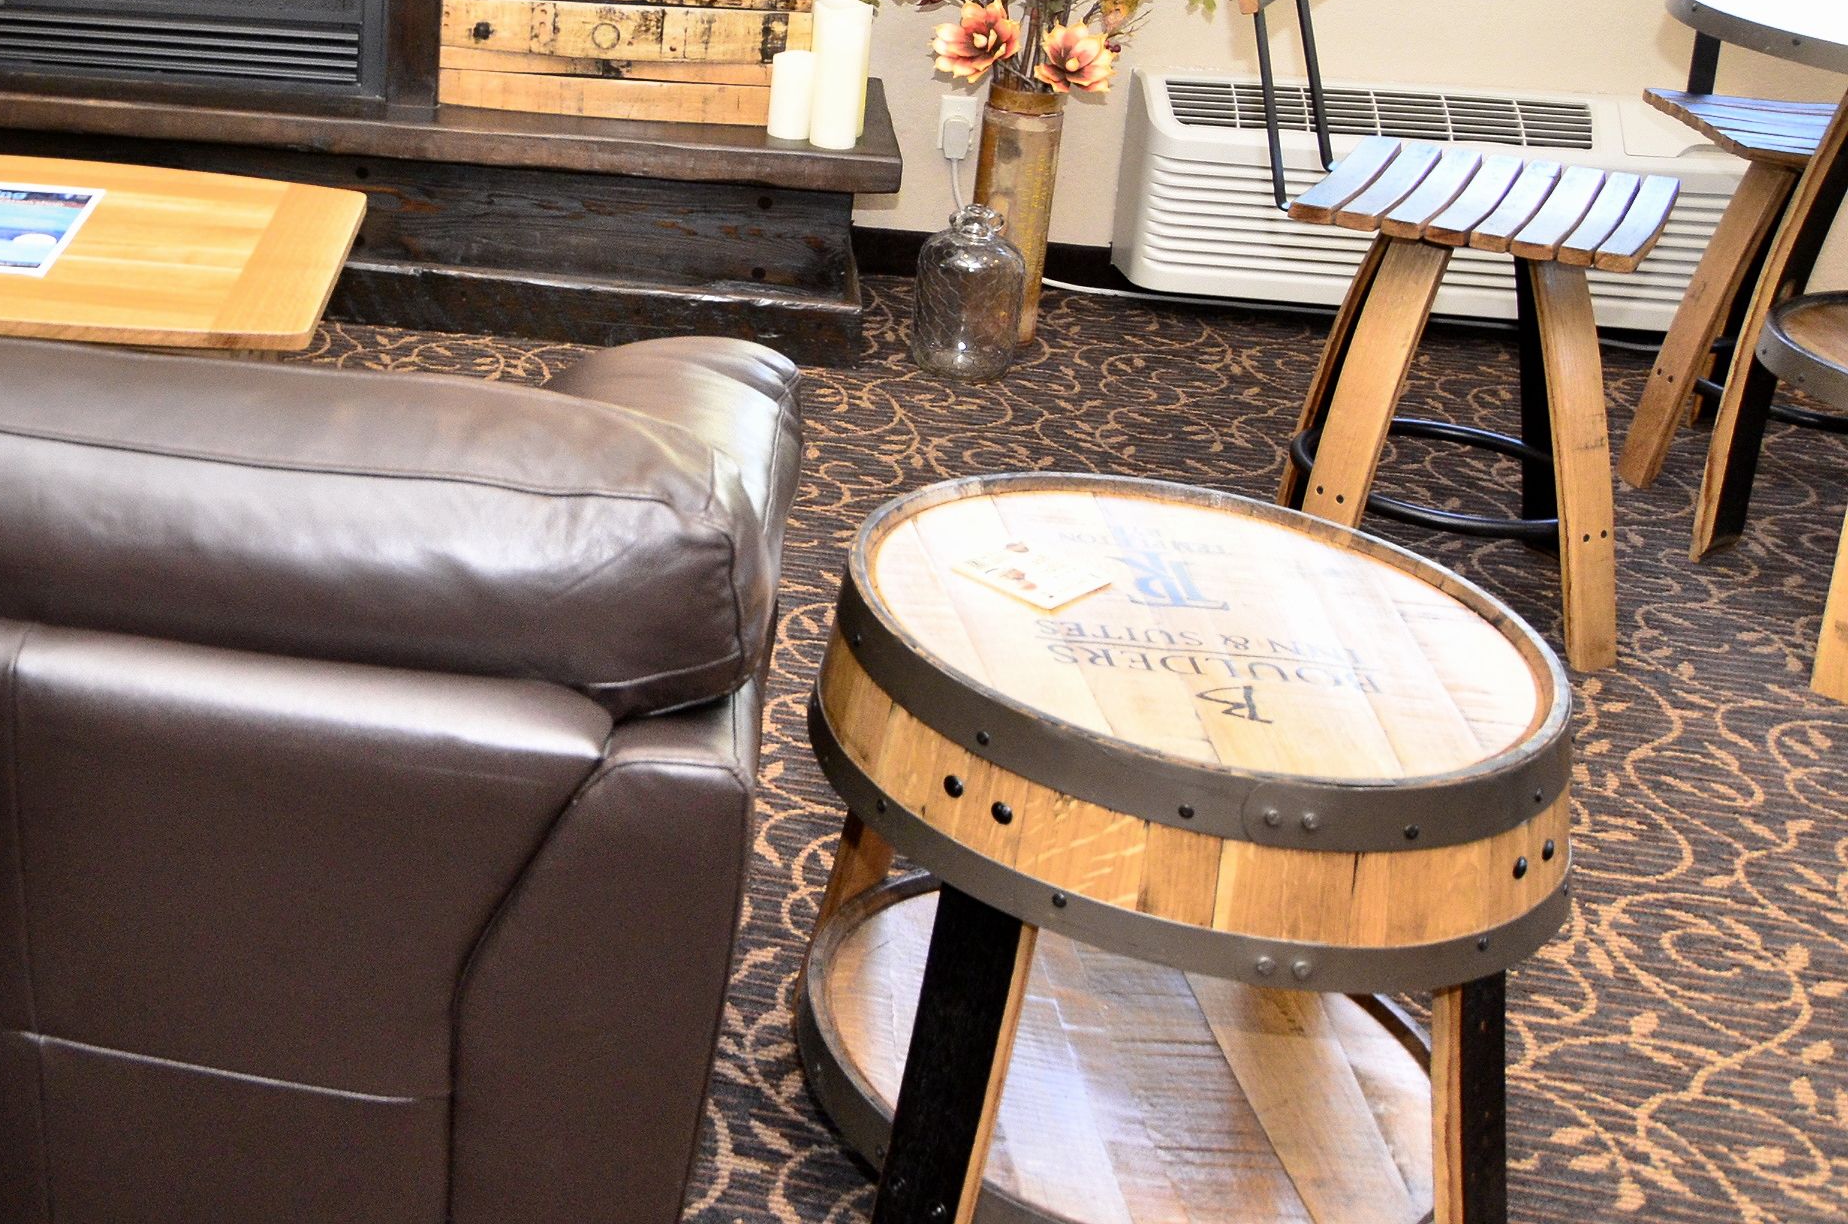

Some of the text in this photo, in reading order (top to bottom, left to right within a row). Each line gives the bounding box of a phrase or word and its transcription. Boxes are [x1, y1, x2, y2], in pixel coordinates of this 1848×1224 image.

[1036, 618, 1364, 665] INN & SUITES
[1047, 643, 1382, 695] BOULDERS
